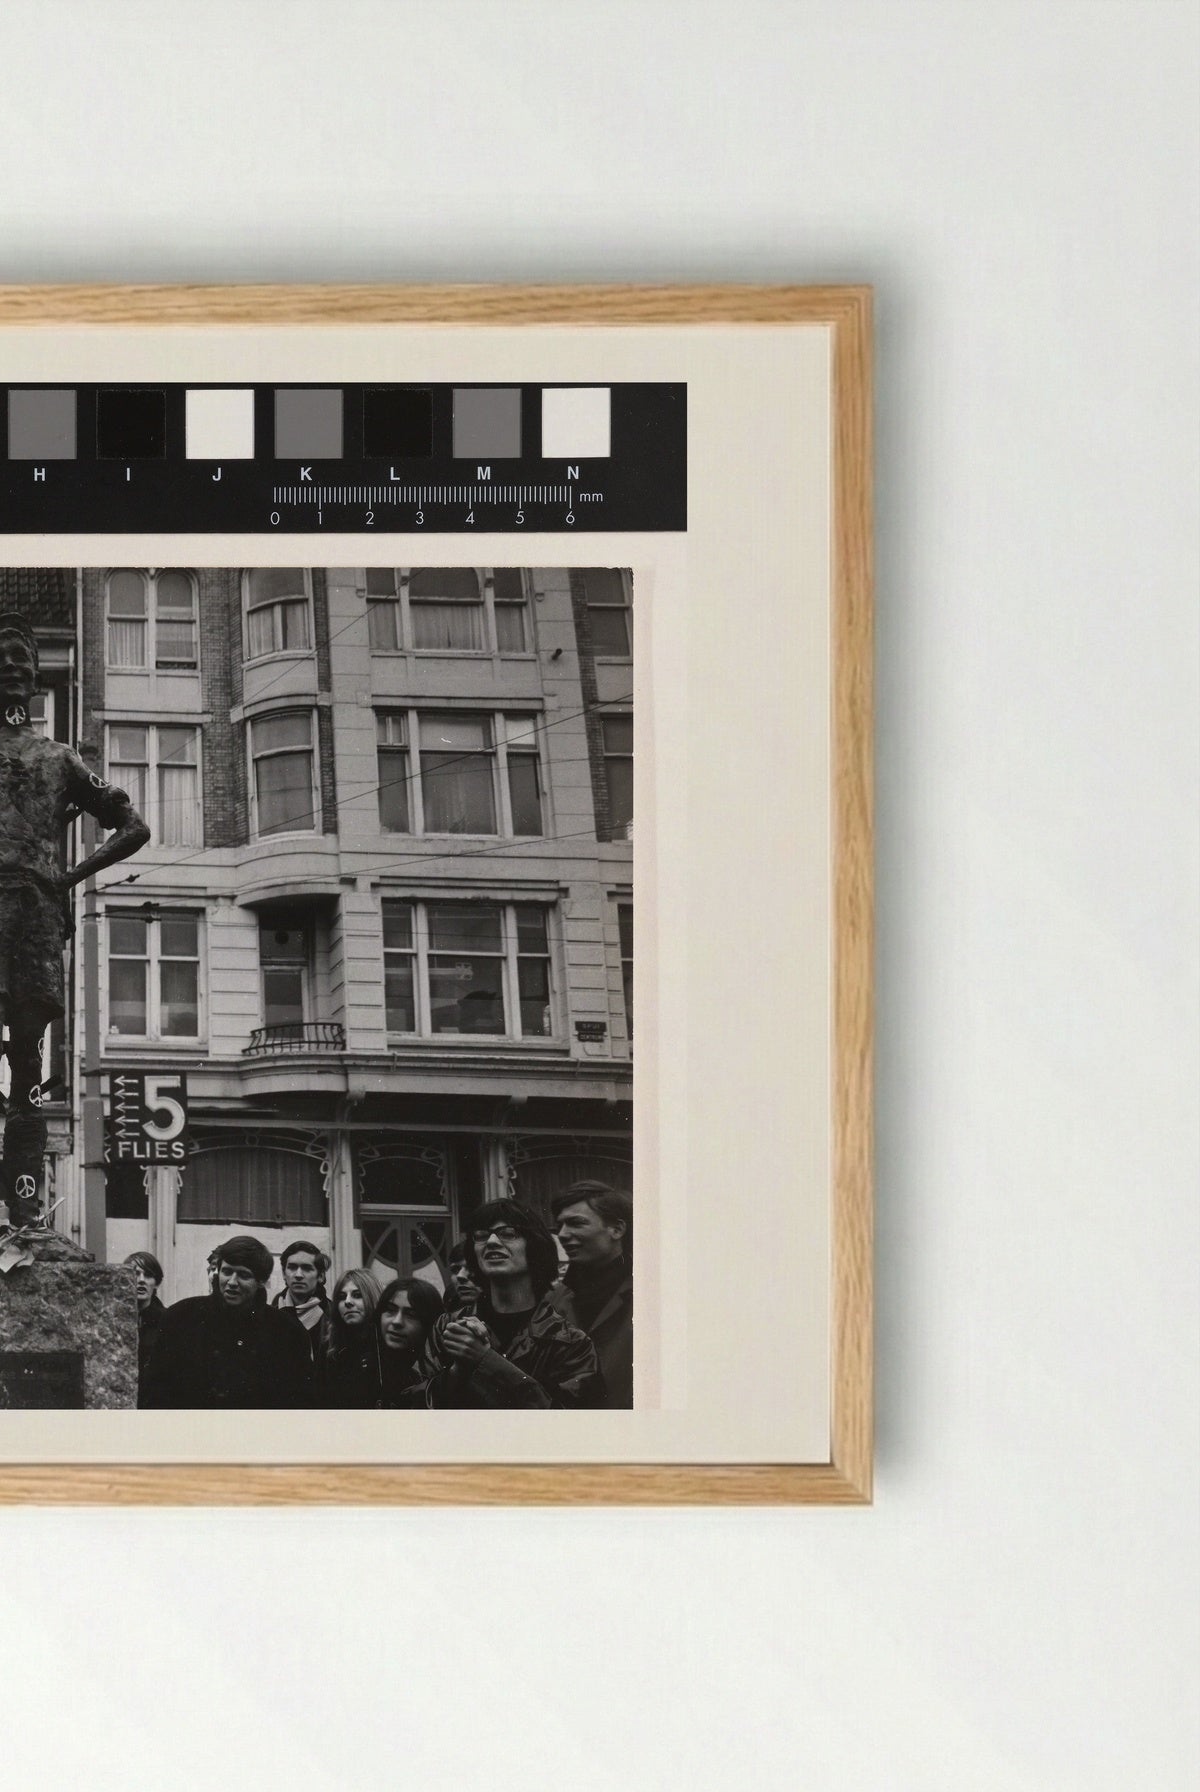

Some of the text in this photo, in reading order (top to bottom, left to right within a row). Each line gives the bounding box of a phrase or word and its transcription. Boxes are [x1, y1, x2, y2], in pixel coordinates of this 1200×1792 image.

[34, 467, 46, 482] H
[212, 467, 222, 482] J
[300, 466, 313, 481] K
[390, 466, 401, 481] L
[477, 466, 491, 481] M
[567, 465, 579, 480] N
[579, 493, 603, 502] mm
[270, 511, 281, 525] 0
[365, 511, 375, 525] 2
[414, 511, 425, 525] 3
[464, 511, 476, 525] 4
[515, 510, 525, 525] 5
[565, 510, 576, 525] 6
[142, 1075, 186, 1141] 5
[117, 1141, 185, 1159] FLIES
